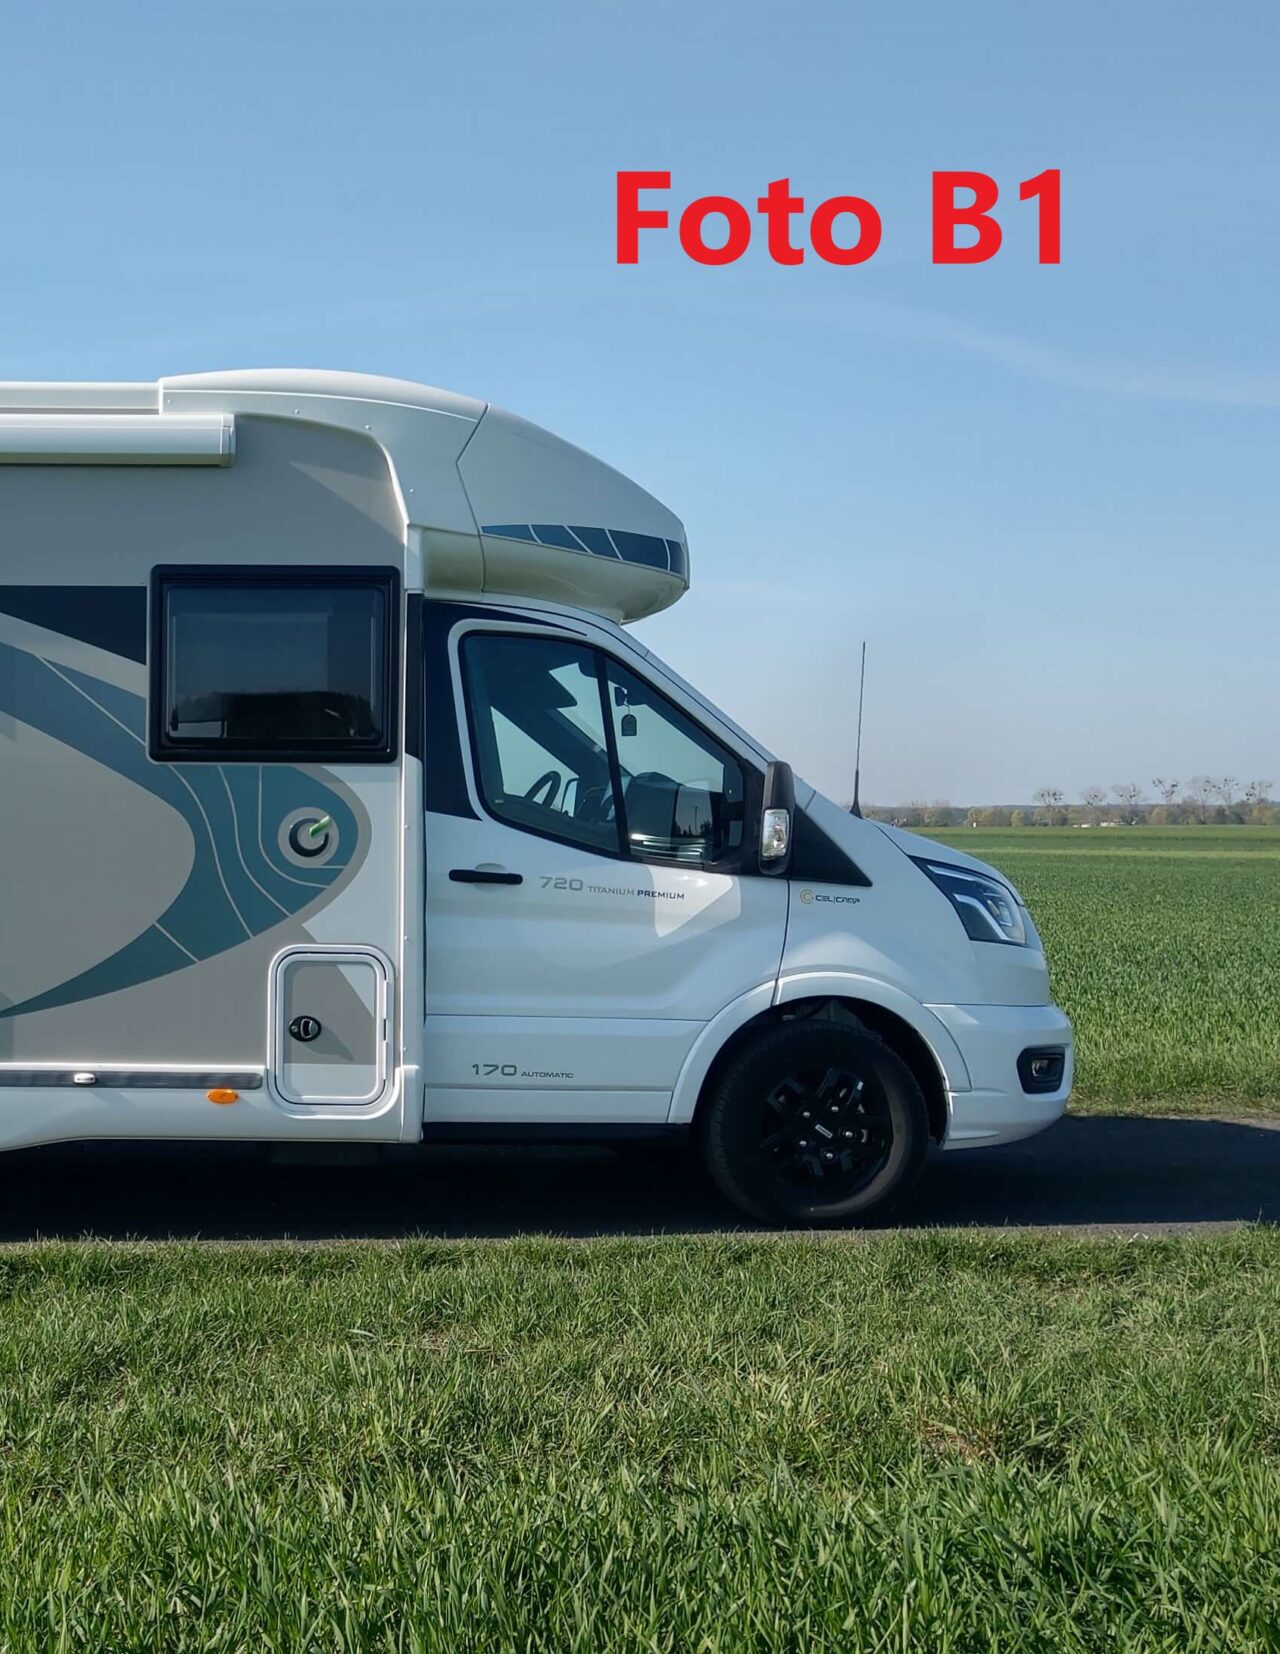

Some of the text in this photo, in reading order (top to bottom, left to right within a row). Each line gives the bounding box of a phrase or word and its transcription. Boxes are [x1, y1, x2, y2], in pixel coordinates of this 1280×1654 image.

[539, 876, 685, 900] 720 TITANIUM PREMIUM
[471, 1063, 575, 1079] 170 AUTOMATIC
